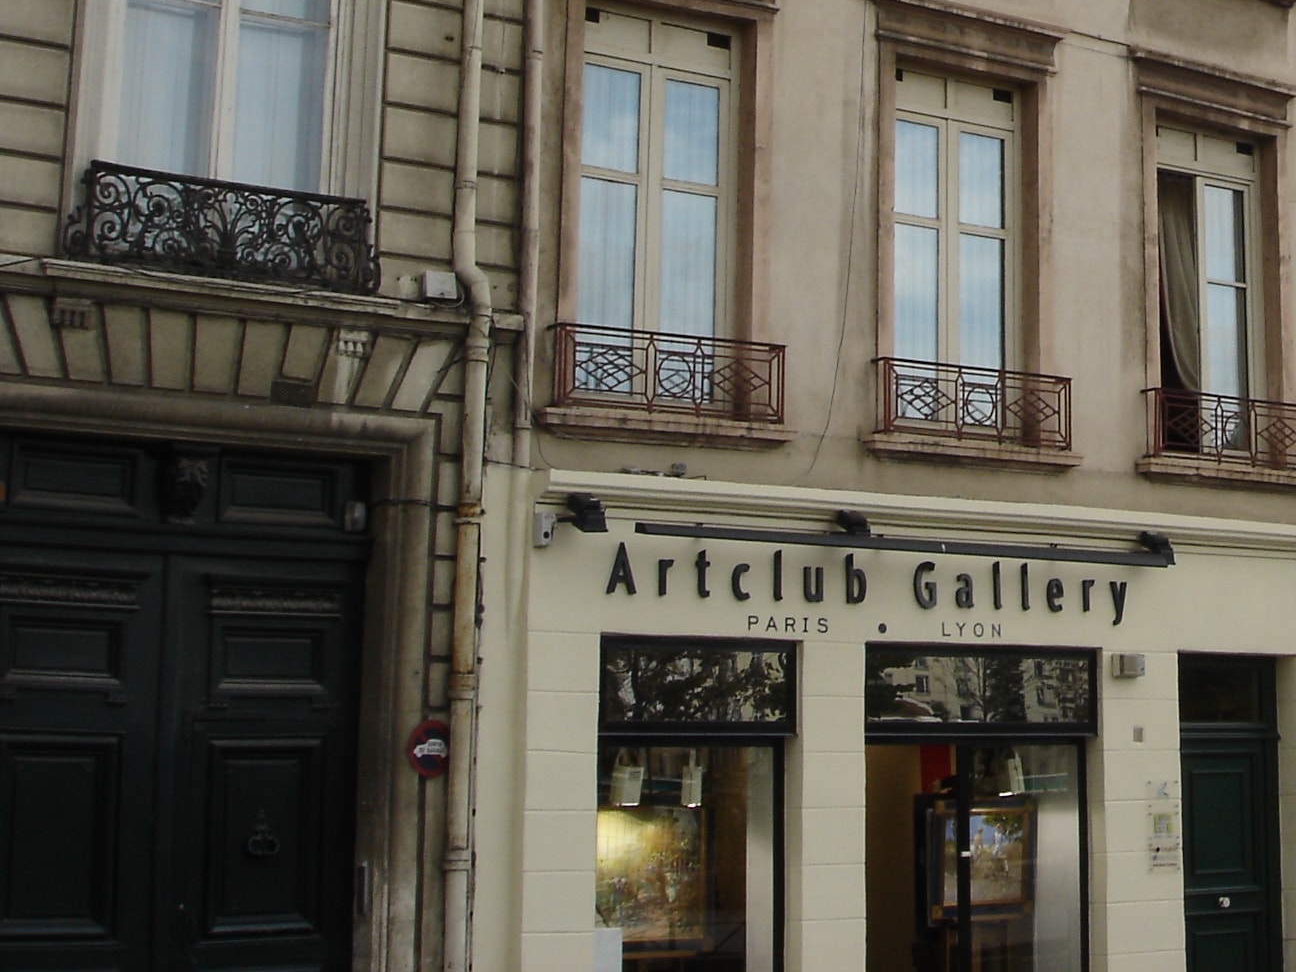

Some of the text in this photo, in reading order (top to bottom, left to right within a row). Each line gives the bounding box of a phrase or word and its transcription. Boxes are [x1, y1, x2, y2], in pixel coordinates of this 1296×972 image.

[606, 541, 1127, 626] Artclub Gallery
[747, 615, 1002, 638] PARIS LYON
